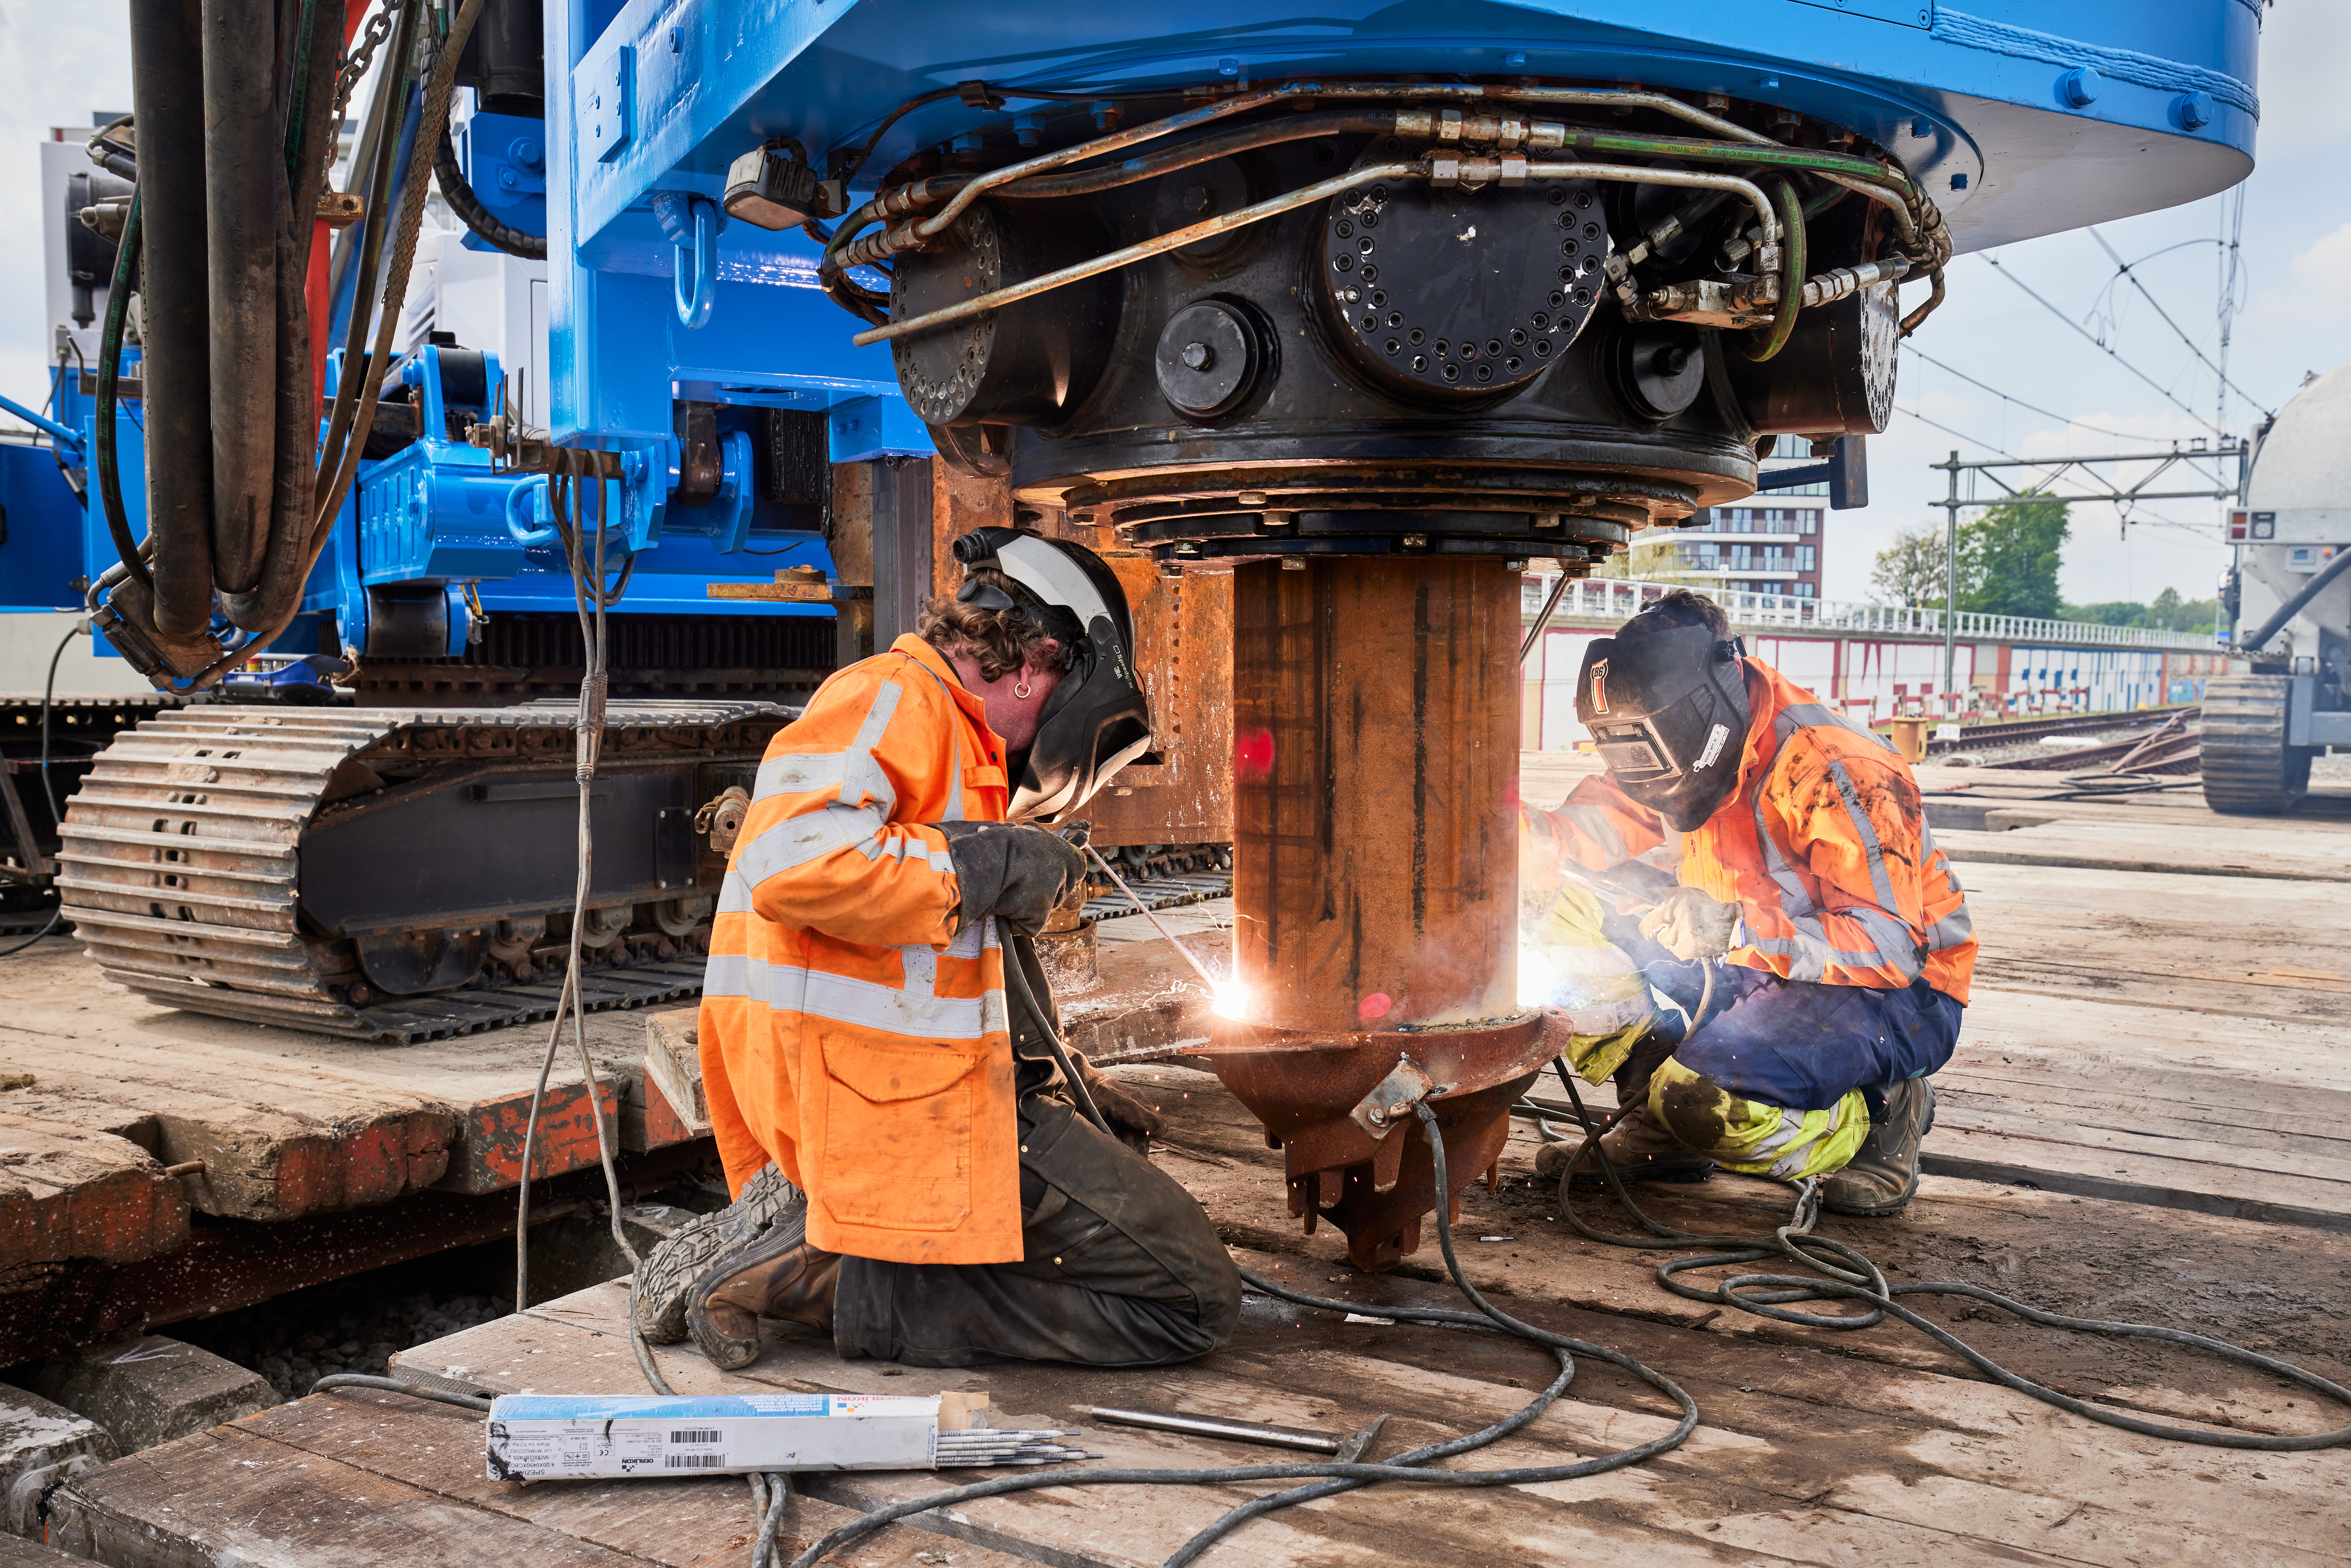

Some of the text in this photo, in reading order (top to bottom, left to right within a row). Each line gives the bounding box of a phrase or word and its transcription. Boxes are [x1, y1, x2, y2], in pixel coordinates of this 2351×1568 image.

[1114, 666, 1123, 679] 3M
[1117, 654, 1133, 689] Speedglas
[1594, 666, 1604, 677] 86
[1702, 724, 1723, 763] WELD
[1710, 728, 1729, 766] RACING
